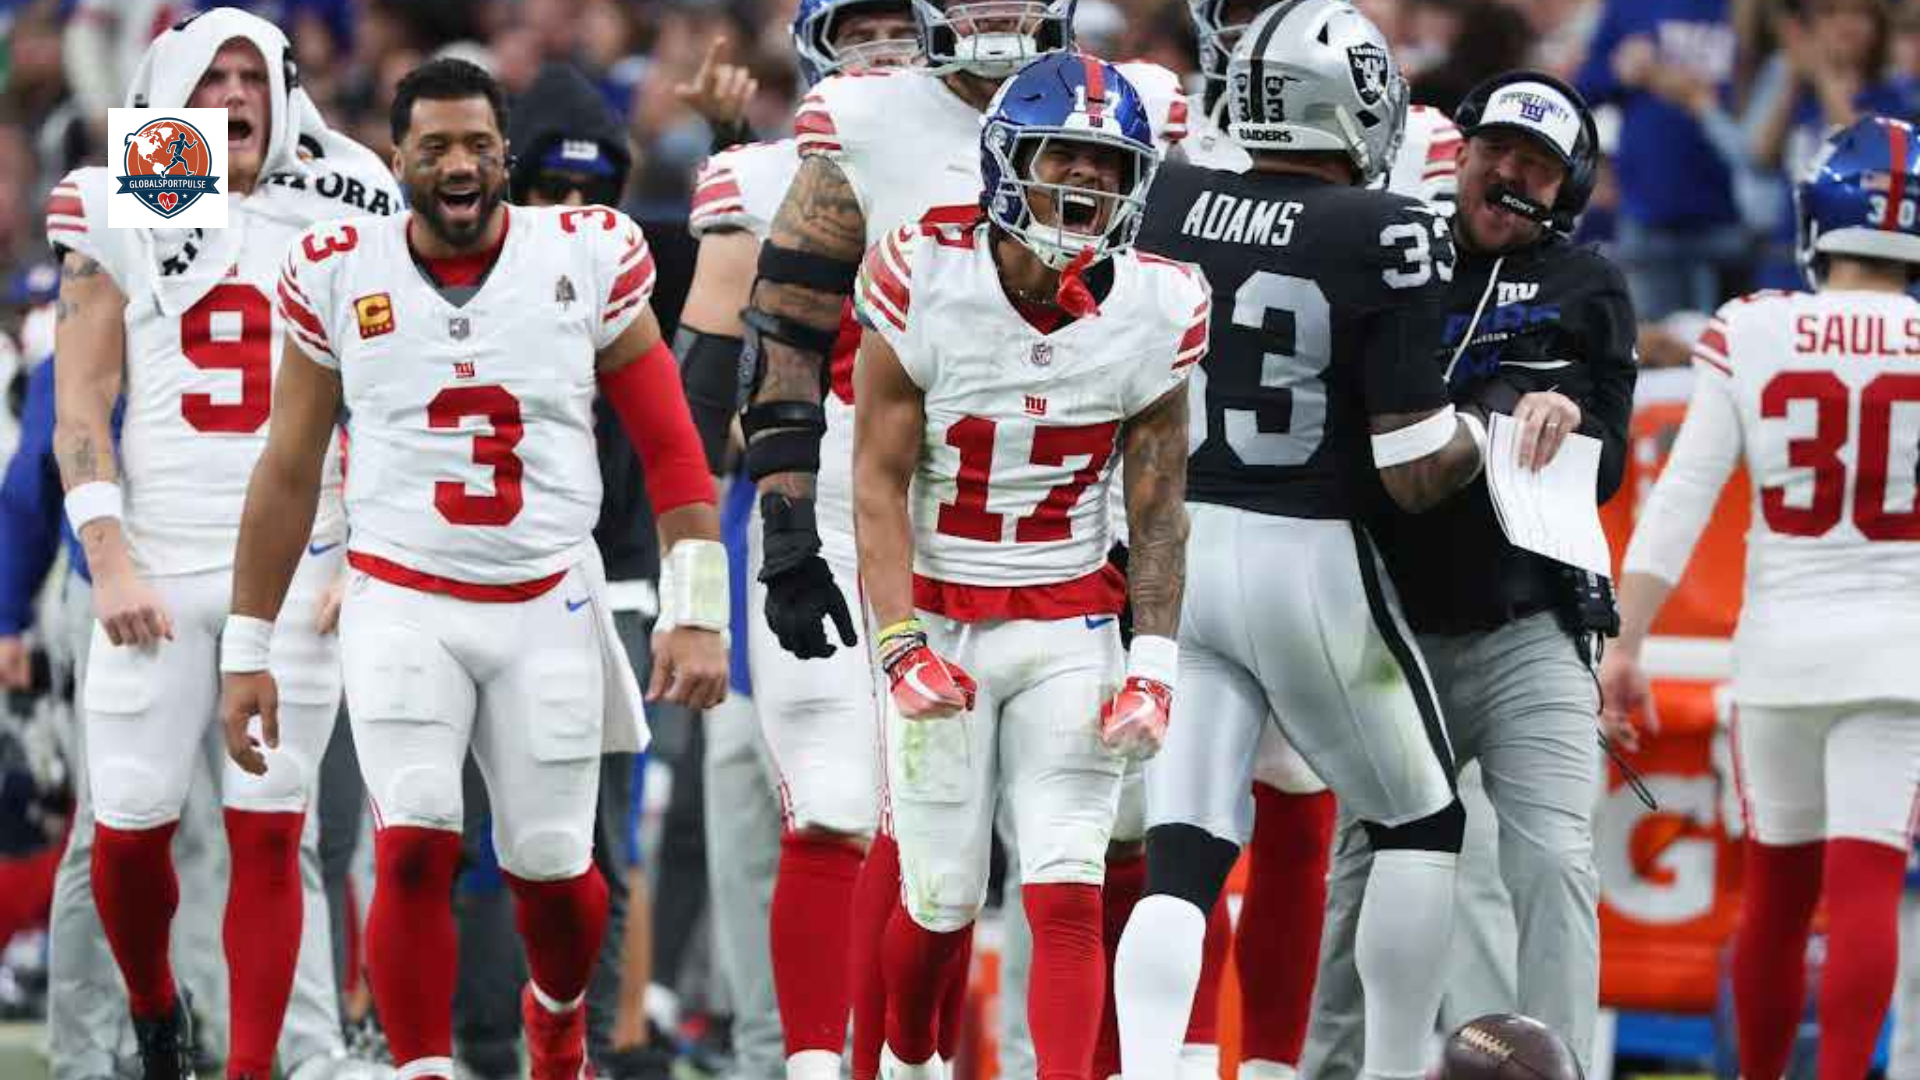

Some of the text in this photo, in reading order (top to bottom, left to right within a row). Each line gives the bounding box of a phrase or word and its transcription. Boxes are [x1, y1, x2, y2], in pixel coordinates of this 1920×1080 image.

[1239, 128, 1293, 143] RAIDERS
[1182, 191, 1304, 247] ADAMS
[1501, 194, 1536, 214] SONY
[1866, 195, 1916, 228] 30
[181, 283, 271, 434] 9
[1188, 271, 1331, 466] 3
[427, 385, 524, 527] 3
[936, 415, 1120, 543] 17
[1760, 370, 1920, 541] 30
[1592, 773, 1718, 925] G
